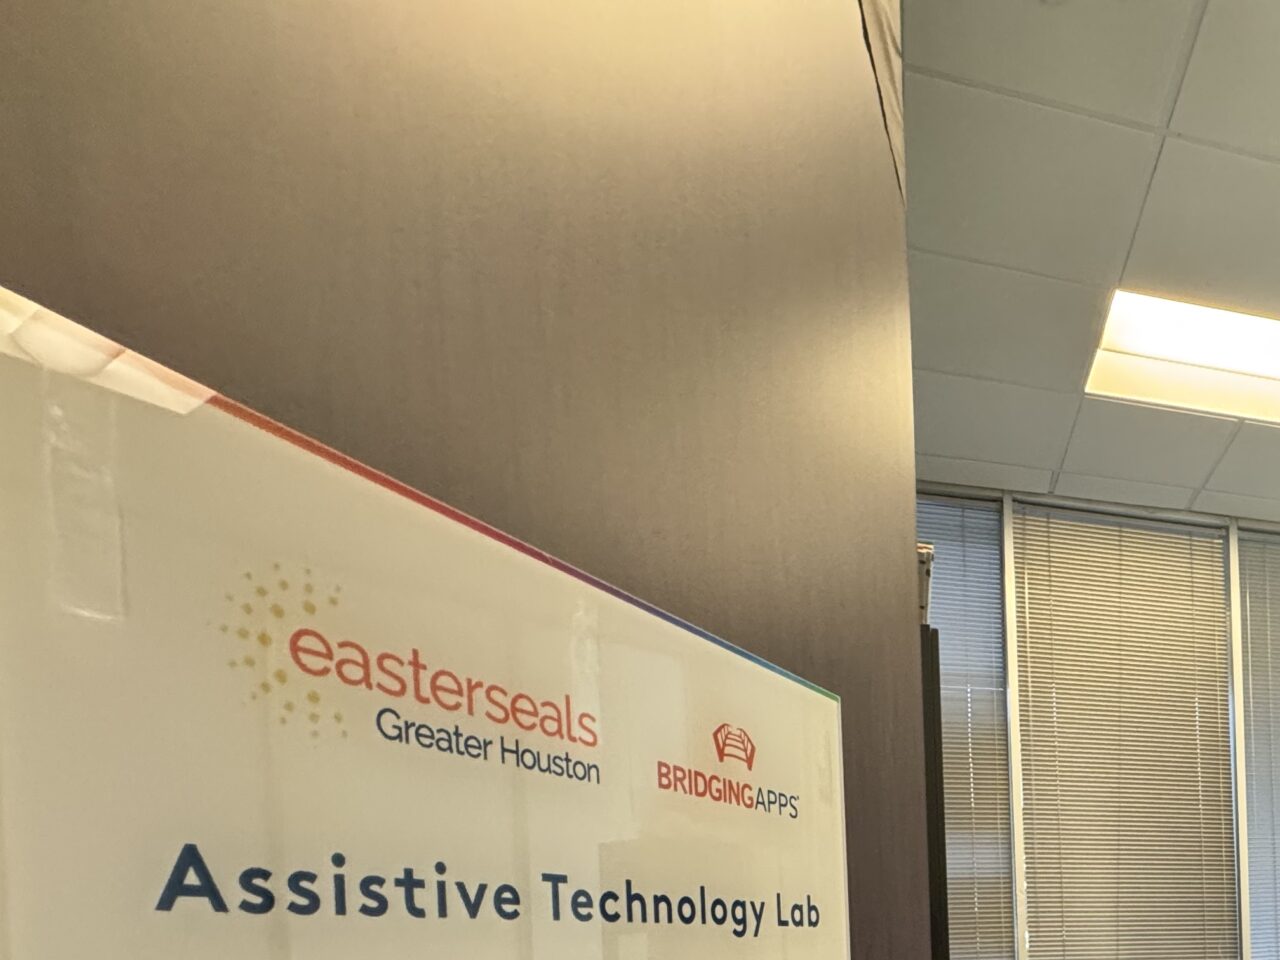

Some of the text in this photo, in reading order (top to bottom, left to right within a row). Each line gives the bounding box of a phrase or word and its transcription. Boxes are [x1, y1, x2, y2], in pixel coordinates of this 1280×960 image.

[289, 628, 598, 747] easterseals
[376, 707, 601, 784] Greater Houston
[154, 843, 820, 938] Assistive Technology Lab
